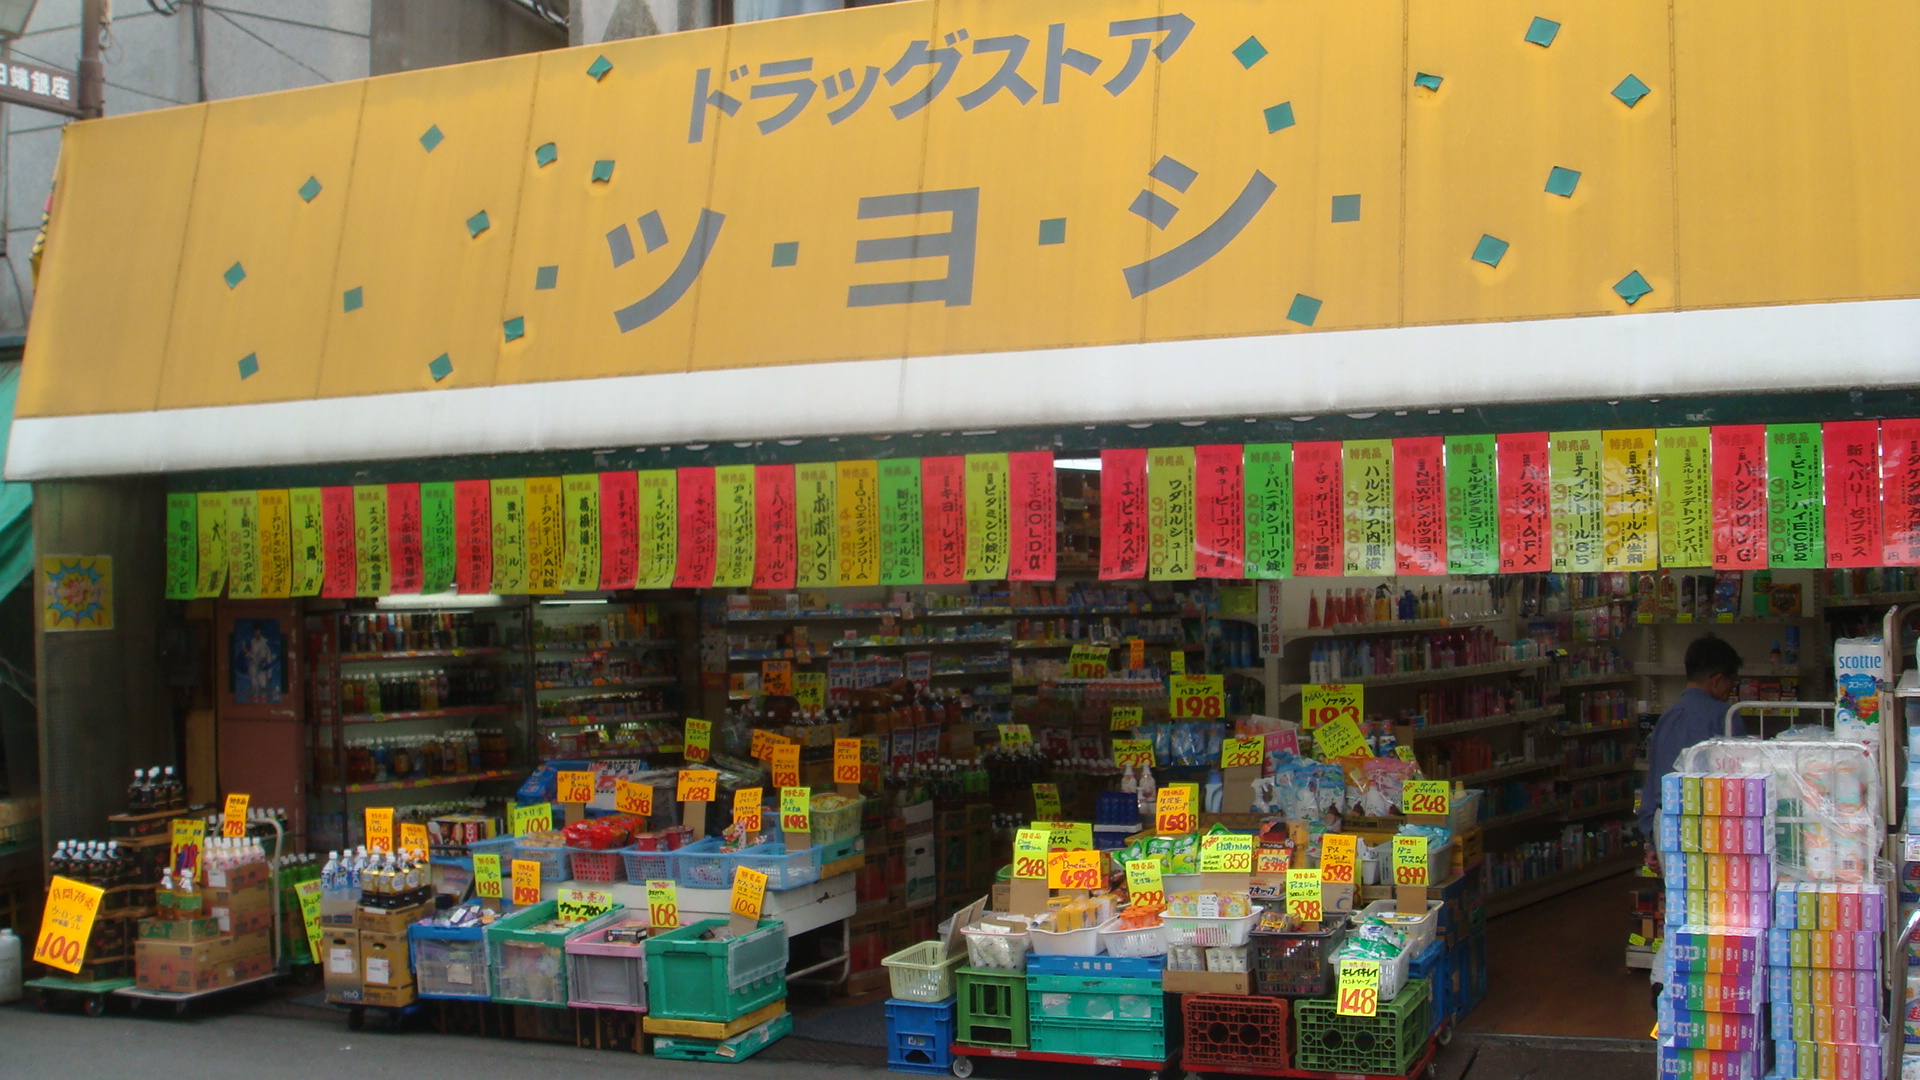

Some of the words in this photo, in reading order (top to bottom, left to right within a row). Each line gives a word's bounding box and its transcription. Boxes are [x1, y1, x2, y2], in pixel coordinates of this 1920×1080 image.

[688, 12, 1195, 144] ドラッグストア
[1556, 438, 1591, 452] 特売品
[1609, 437, 1645, 450] 特売品
[1773, 431, 1810, 444] 特売品
[1350, 446, 1381, 460] 特売品
[1451, 442, 1485, 455] 特売品
[1847, 443, 1867, 558] 新ヘパリーゼプラス
[1364, 465, 1382, 571] ハルンケア内服液
[1519, 465, 1539, 566] パスタイムFX
[1572, 465, 1590, 565] ナイシトール85
[1625, 464, 1643, 564] ボラギノールA坐剤
[1680, 461, 1698, 562] スルーラックデトファイバー
[1735, 460, 1752, 563] パンシロンG
[1771, 477, 1787, 563] 3580円
[896, 488, 912, 579] 新ビオフェルミン
[940, 489, 958, 578] キヨーレオピン
[1119, 481, 1137, 574] エビオス錠
[1168, 478, 1185, 575] ワダカルシューム
[771, 495, 785, 583] ハイチオールC
[813, 493, 829, 581] ポポンS
[1072, 663, 1107, 679] 178
[1838, 655, 1882, 669] scottie
[1180, 686, 1213, 696] ハミング
[1175, 695, 1222, 718] 198
[685, 744, 709, 761] 100
[1117, 752, 1153, 769] 298
[1226, 750, 1261, 768] 268
[774, 772, 798, 787] 128
[837, 765, 859, 781] 128
[685, 787, 711, 801] 128
[1411, 793, 1446, 814] 248
[625, 796, 650, 815] 398
[226, 820, 244, 836] 78
[783, 814, 808, 830] 198
[1158, 812, 1189, 832] 158
[1016, 857, 1047, 877] 248
[1223, 853, 1251, 870] 358
[1261, 862, 1288, 872] 598
[1060, 868, 1099, 889] 498
[1321, 863, 1353, 882] 598
[1396, 866, 1427, 885] 899
[477, 881, 501, 896] 198
[515, 886, 540, 903] 198
[1131, 890, 1165, 907] 299
[650, 904, 679, 927] 168
[1288, 899, 1322, 921] 398
[1341, 967, 1379, 978] キレイキレイ
[1340, 987, 1377, 1015] 148
